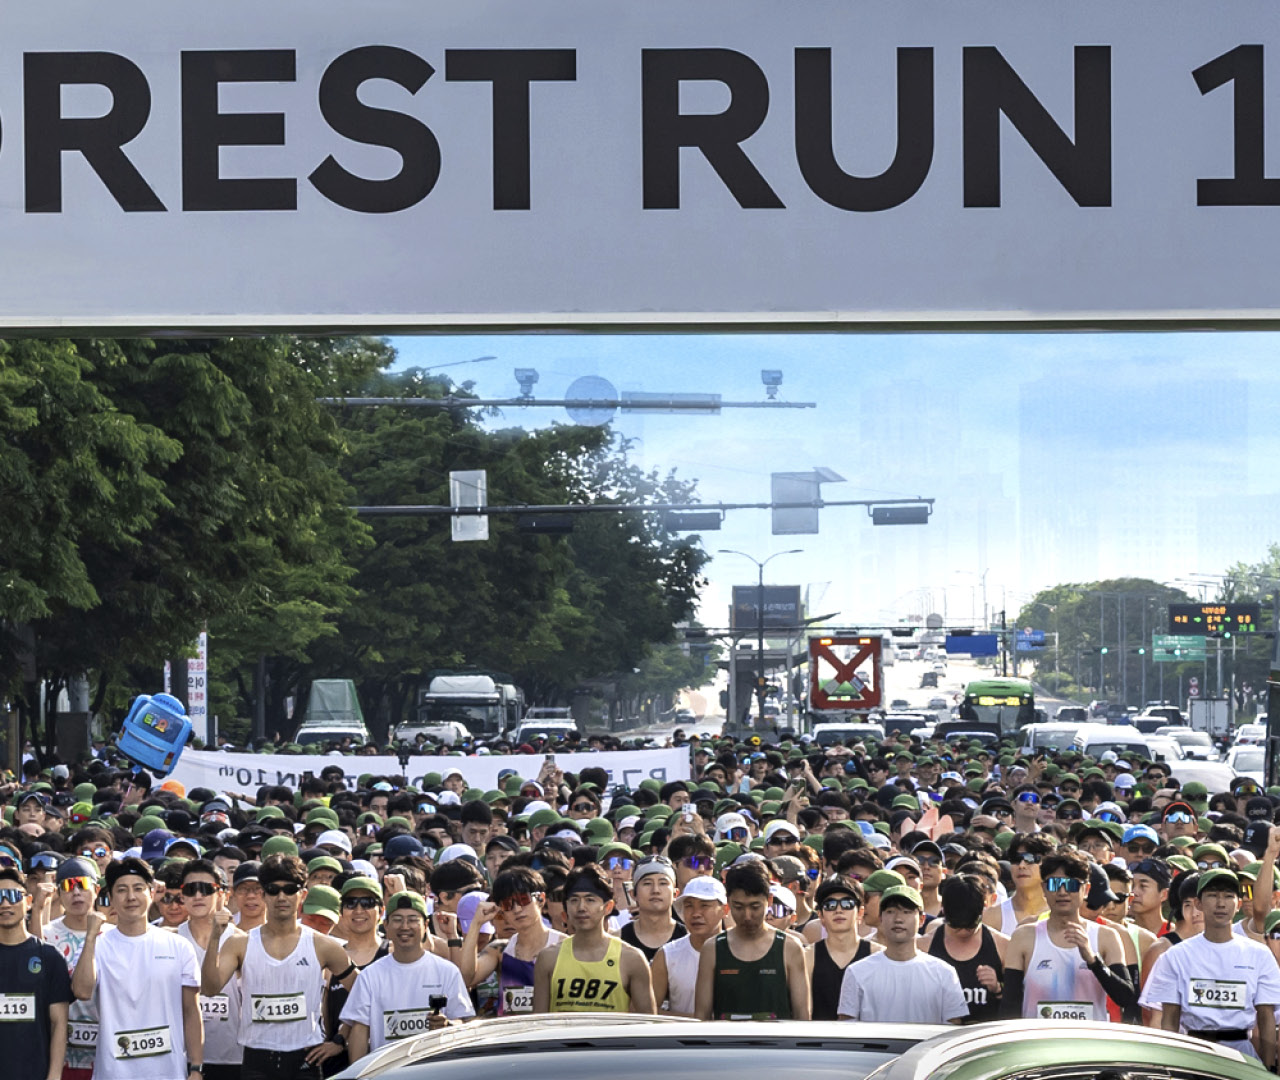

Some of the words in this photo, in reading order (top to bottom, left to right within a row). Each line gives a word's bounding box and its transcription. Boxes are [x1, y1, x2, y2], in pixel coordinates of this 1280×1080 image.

[642, 43, 1112, 213] RUN
[557, 978, 618, 1000] 1987
[1206, 989, 1238, 1002] 0231
[200, 1002, 227, 1013] 123
[267, 1003, 299, 1016] 1189
[131, 1037, 164, 1051] 1093
